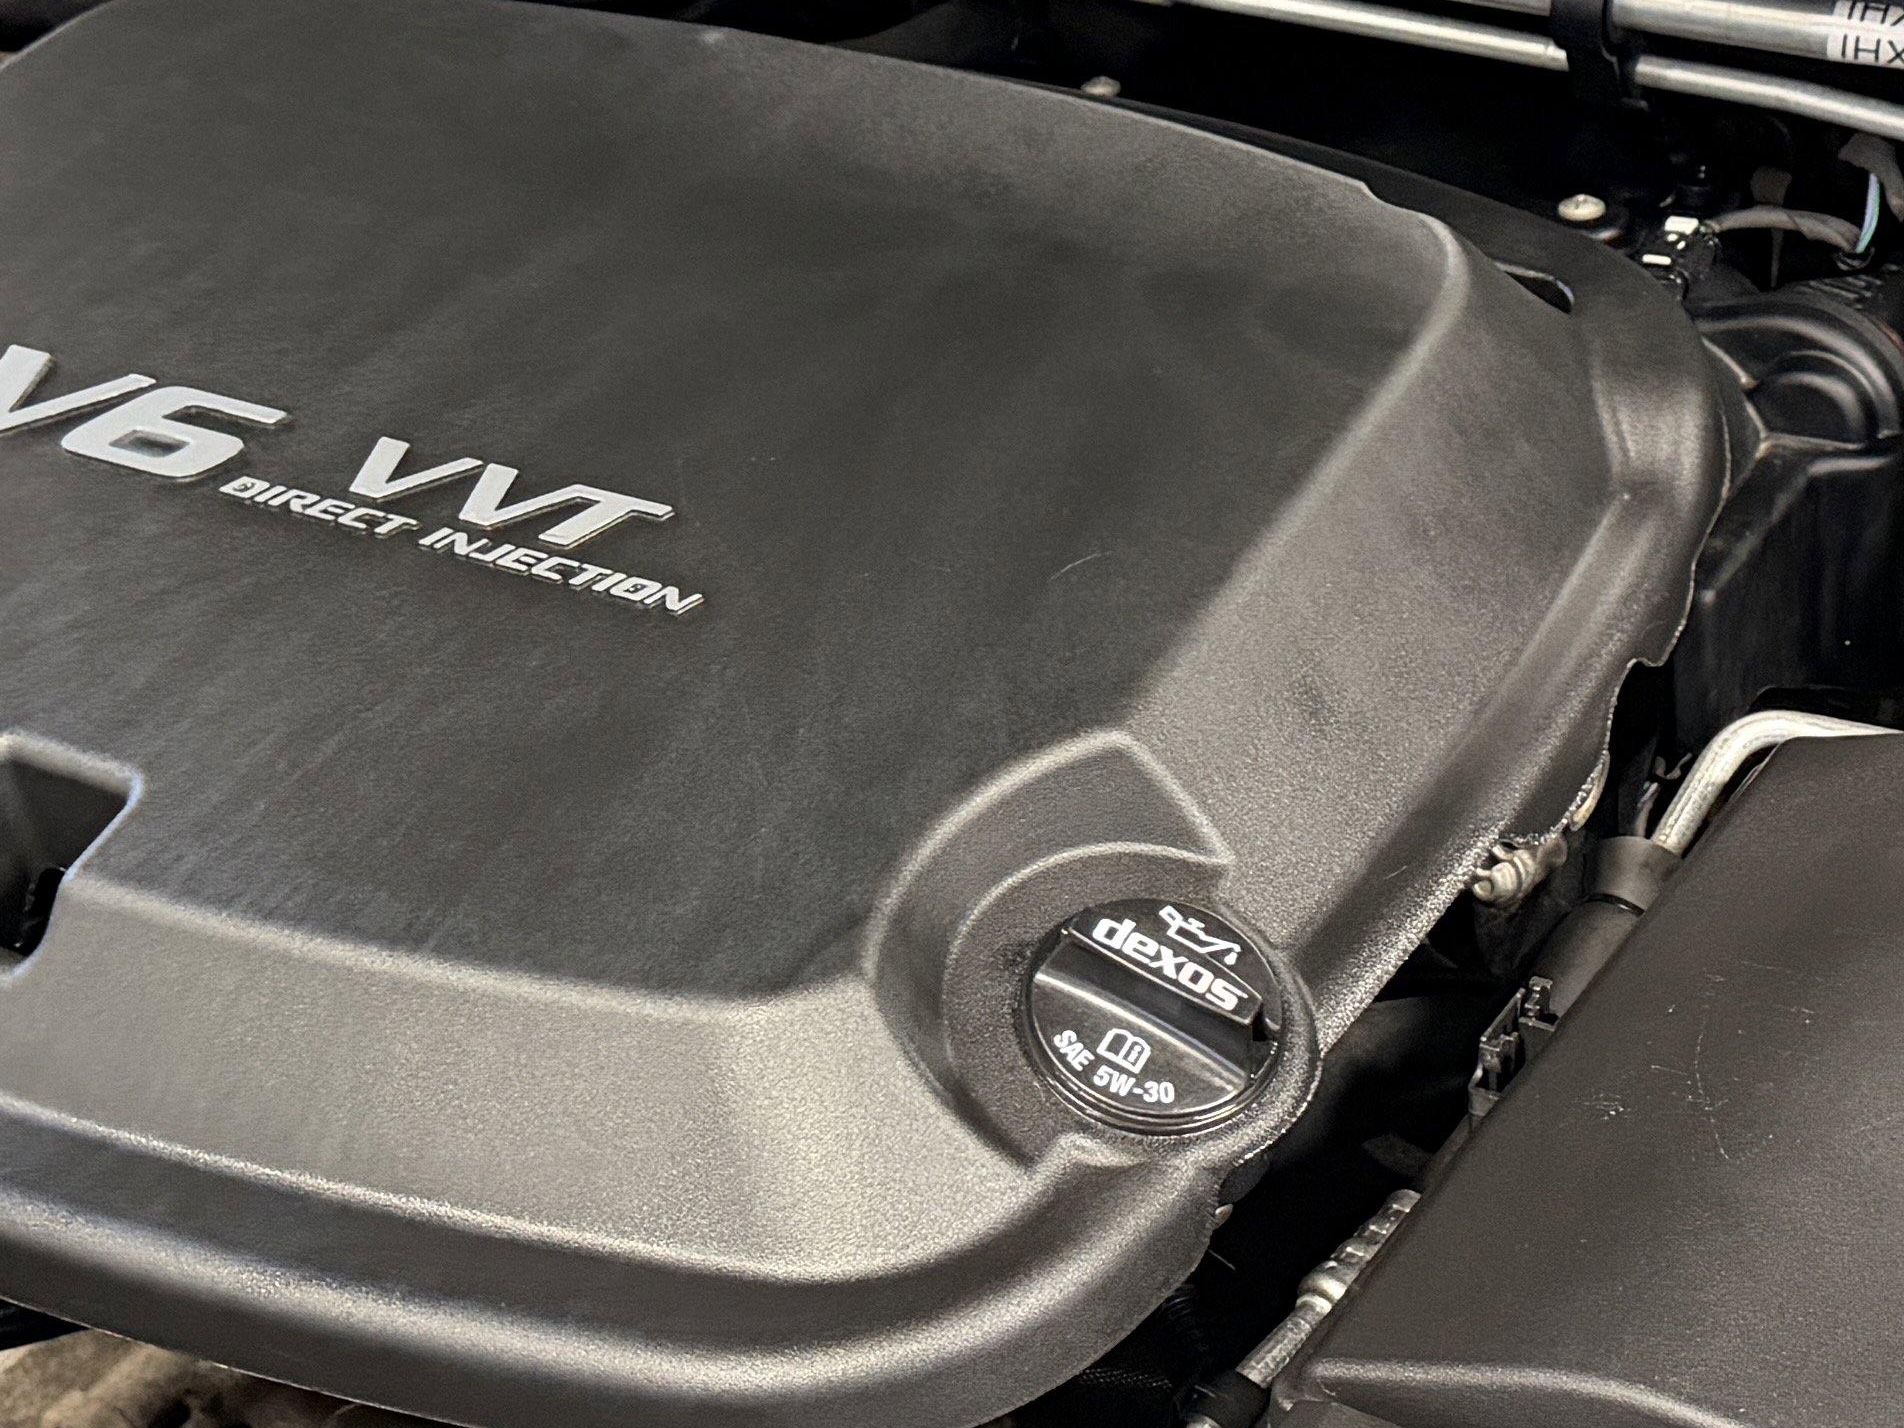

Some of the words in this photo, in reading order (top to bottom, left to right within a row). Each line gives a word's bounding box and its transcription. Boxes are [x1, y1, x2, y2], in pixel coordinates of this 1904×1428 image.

[348, 435, 677, 548] VVT
[217, 474, 422, 539] DIRECT
[418, 525, 705, 615] INJECTION
[1092, 917, 1248, 1011] dexos
[1053, 1029, 1094, 1071] SAE
[1093, 1068, 1175, 1104] 5W-30
